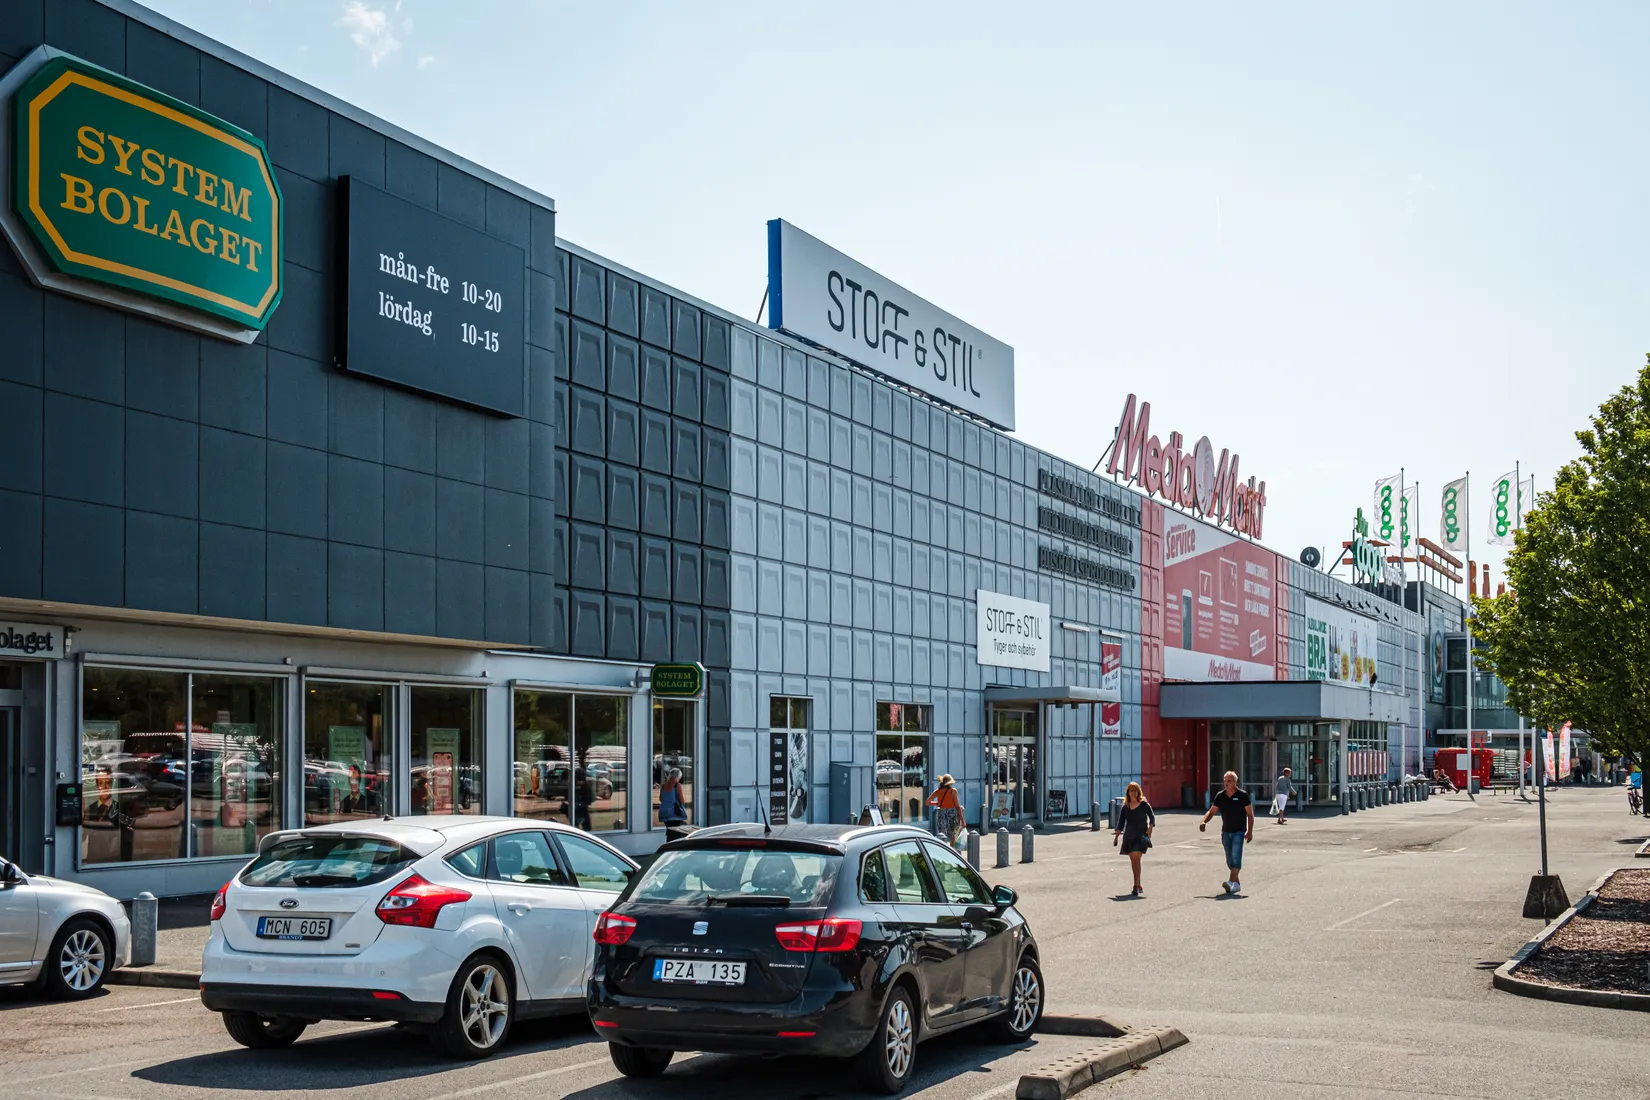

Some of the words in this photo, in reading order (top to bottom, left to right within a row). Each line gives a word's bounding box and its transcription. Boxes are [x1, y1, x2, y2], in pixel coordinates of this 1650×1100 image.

[77, 125, 253, 223] SYSTEM
[60, 172, 262, 273] BOLAGET
[379, 251, 450, 295] mån-fre
[461, 280, 502, 313] 10-20
[378, 292, 433, 336] lördag
[461, 322, 500, 353] 10-15
[827, 269, 909, 361] STOFF
[914, 329, 928, 368] &
[933, 327, 981, 399] STIL
[1166, 528, 1196, 560] Service
[986, 607, 1016, 635] STOFF
[1017, 618, 1022, 634] &
[1024, 614, 1042, 640] STIL
[1307, 633, 1327, 671] BRA
[656, 680, 694, 688] BOLAGET
[658, 672, 692, 680] SYSTEM
[265, 919, 292, 934] MCN
[300, 920, 326, 935] 605
[663, 962, 694, 979] PZA
[711, 963, 741, 980] 135
